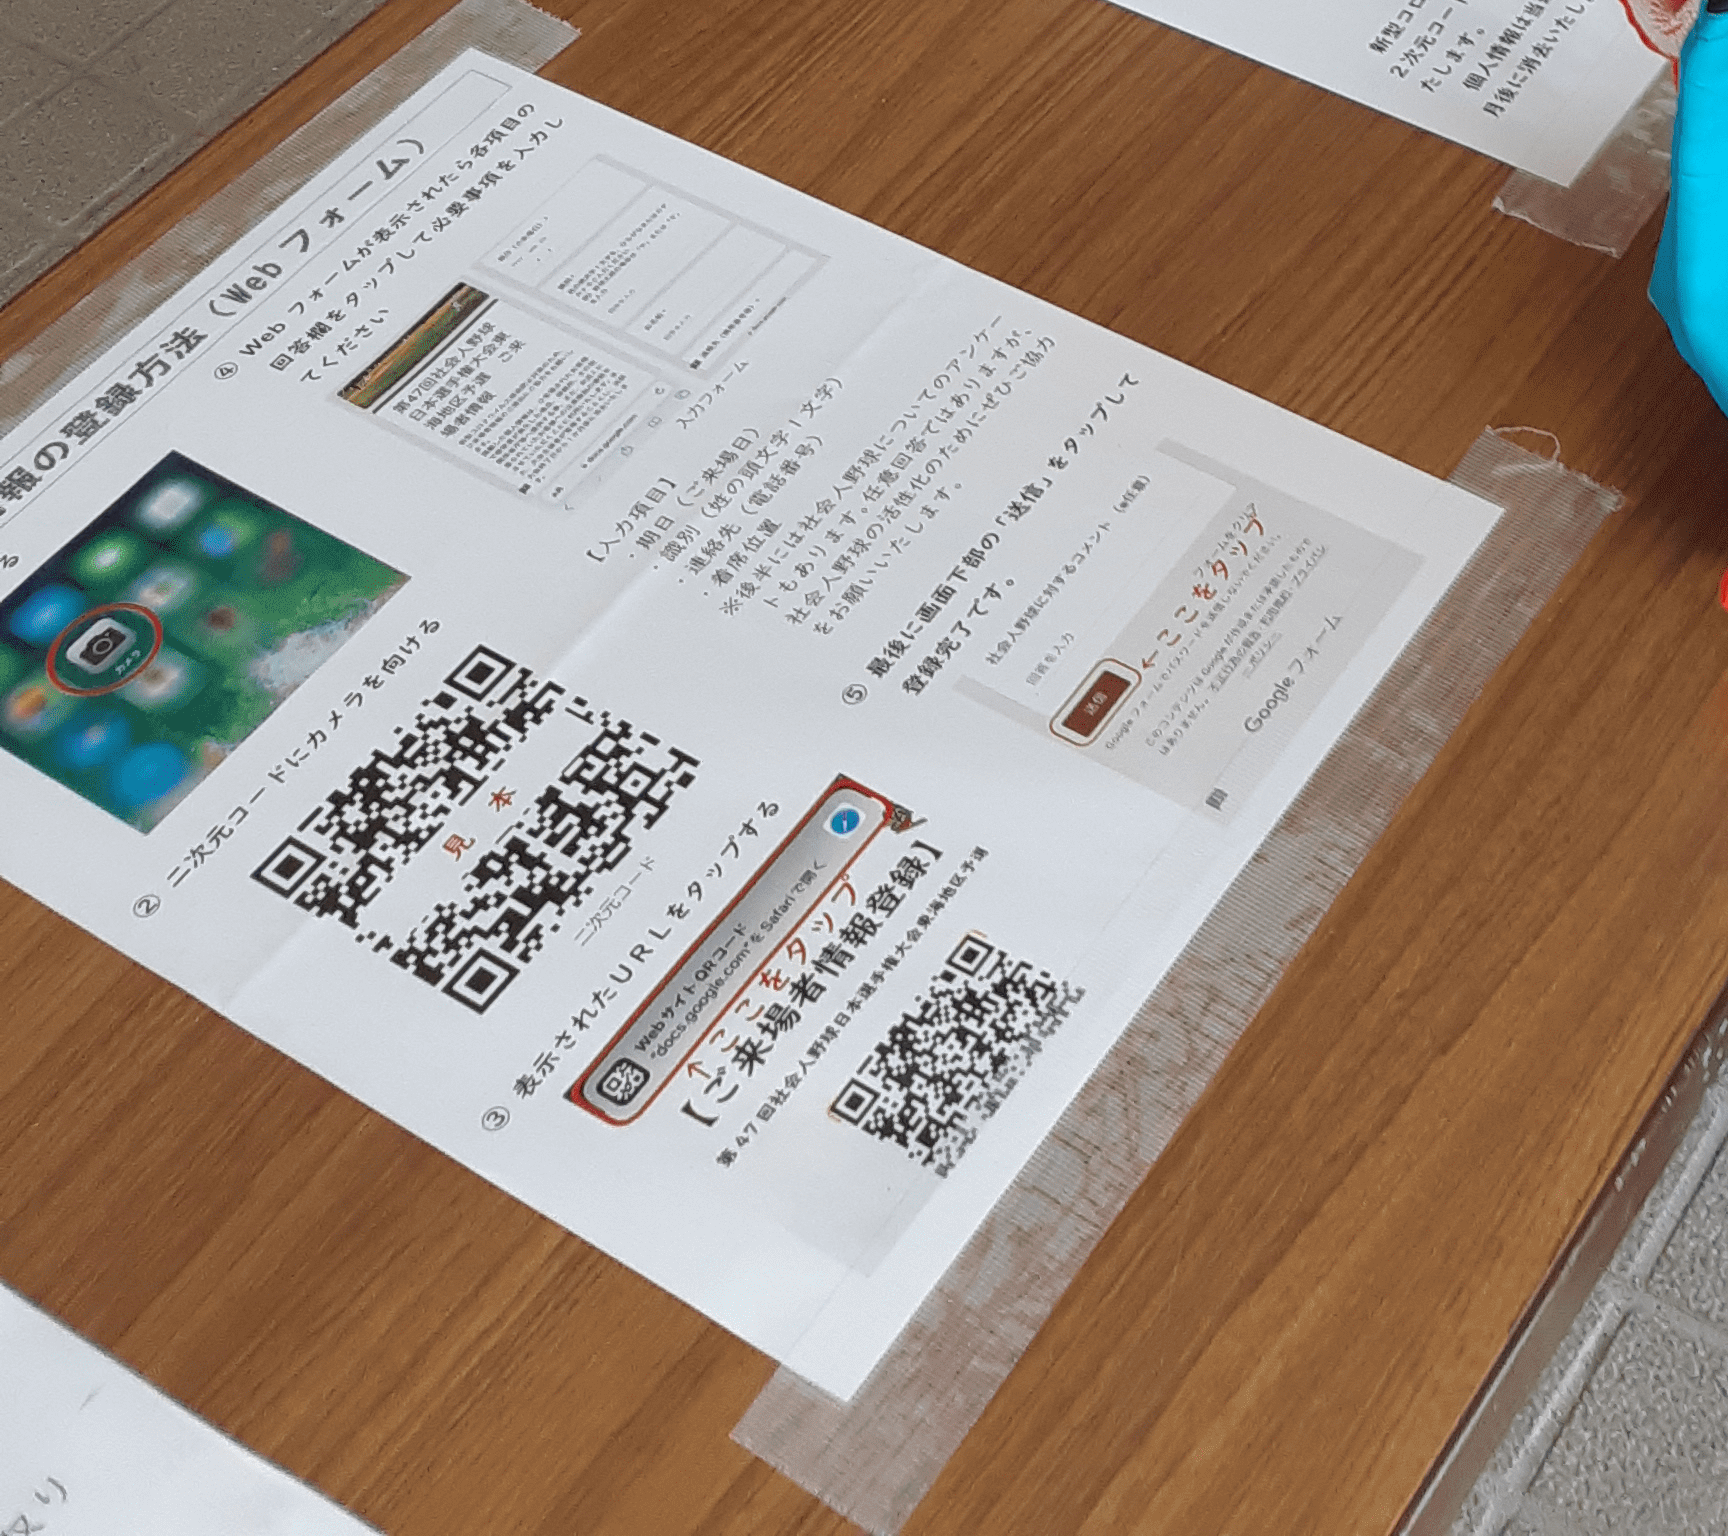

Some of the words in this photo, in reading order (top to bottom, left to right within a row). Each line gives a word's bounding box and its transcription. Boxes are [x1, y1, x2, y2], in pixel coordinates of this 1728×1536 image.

[1421, 29, 1484, 92] たします。
[269, 119, 562, 371] 回答欄をタップして必要事項を入力し
[300, 310, 389, 381] てください
[676, 363, 749, 429] 入力フォーム
[586, 478, 676, 562] 【入力項目】
[785, 337, 1055, 624] 社会人野球の活性化のためにぜひご協力
[813, 484, 961, 634] をお願いいたします。
[902, 579, 1014, 696] 登録完了です。
[1244, 677, 1295, 732] Google
[574, 856, 654, 946] 二次元コード
[681, 840, 943, 1127] 【ご来場者情報登録】
[709, 874, 857, 1052] ここをタップ
